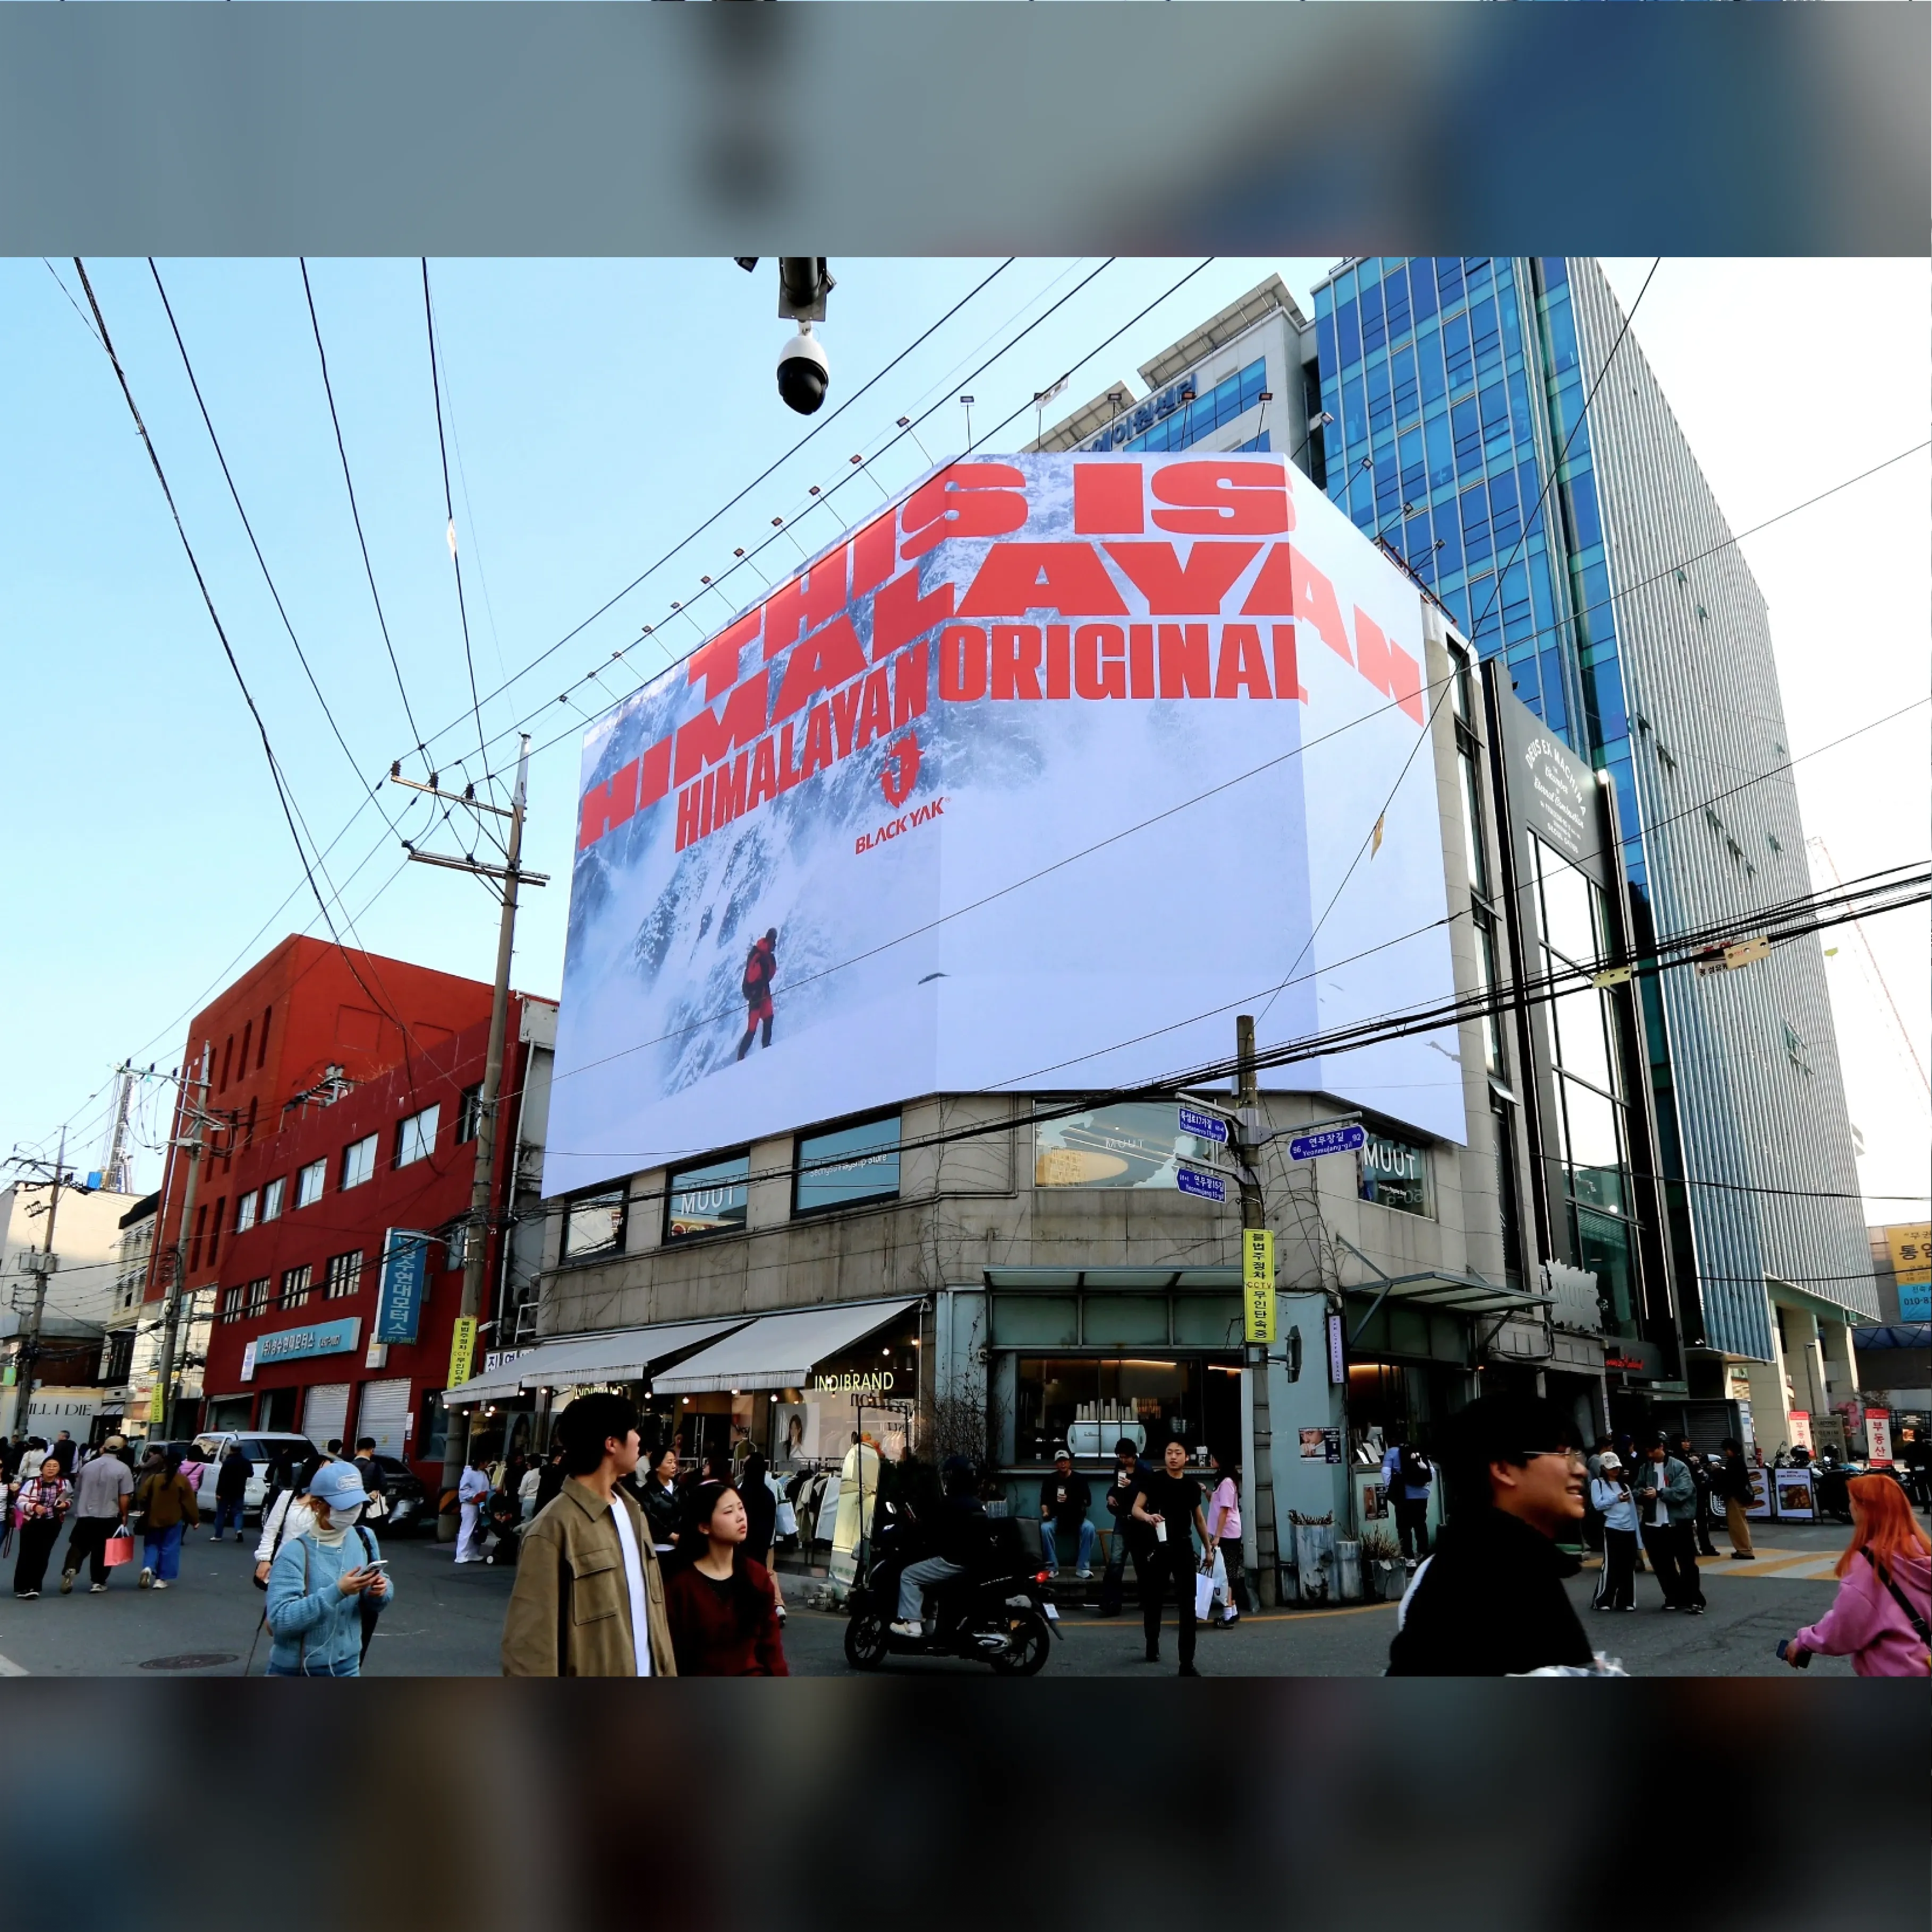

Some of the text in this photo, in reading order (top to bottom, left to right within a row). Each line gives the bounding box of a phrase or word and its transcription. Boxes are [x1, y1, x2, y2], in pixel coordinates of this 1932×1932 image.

[688, 461, 1297, 704] THIS IS
[578, 541, 1425, 851] HIMALAYAN
[675, 623, 1309, 852] HIMALAYAN ORIGINAL
[1554, 747, 1586, 816] MACHINA
[855, 797, 944, 854] BLACK YAK
[1309, 1132, 1344, 1148] 연무장길
[1364, 1142, 1415, 1180] MUUT
[681, 1185, 734, 1215] MUUT
[1252, 1233, 1266, 1279] 불법주정차
[1254, 1291, 1267, 1338] 무인단속중
[815, 1371, 894, 1393] INDIBRAND
[65, 1404, 92, 1416] DIE
[1872, 1421, 1886, 1457] 부동산
